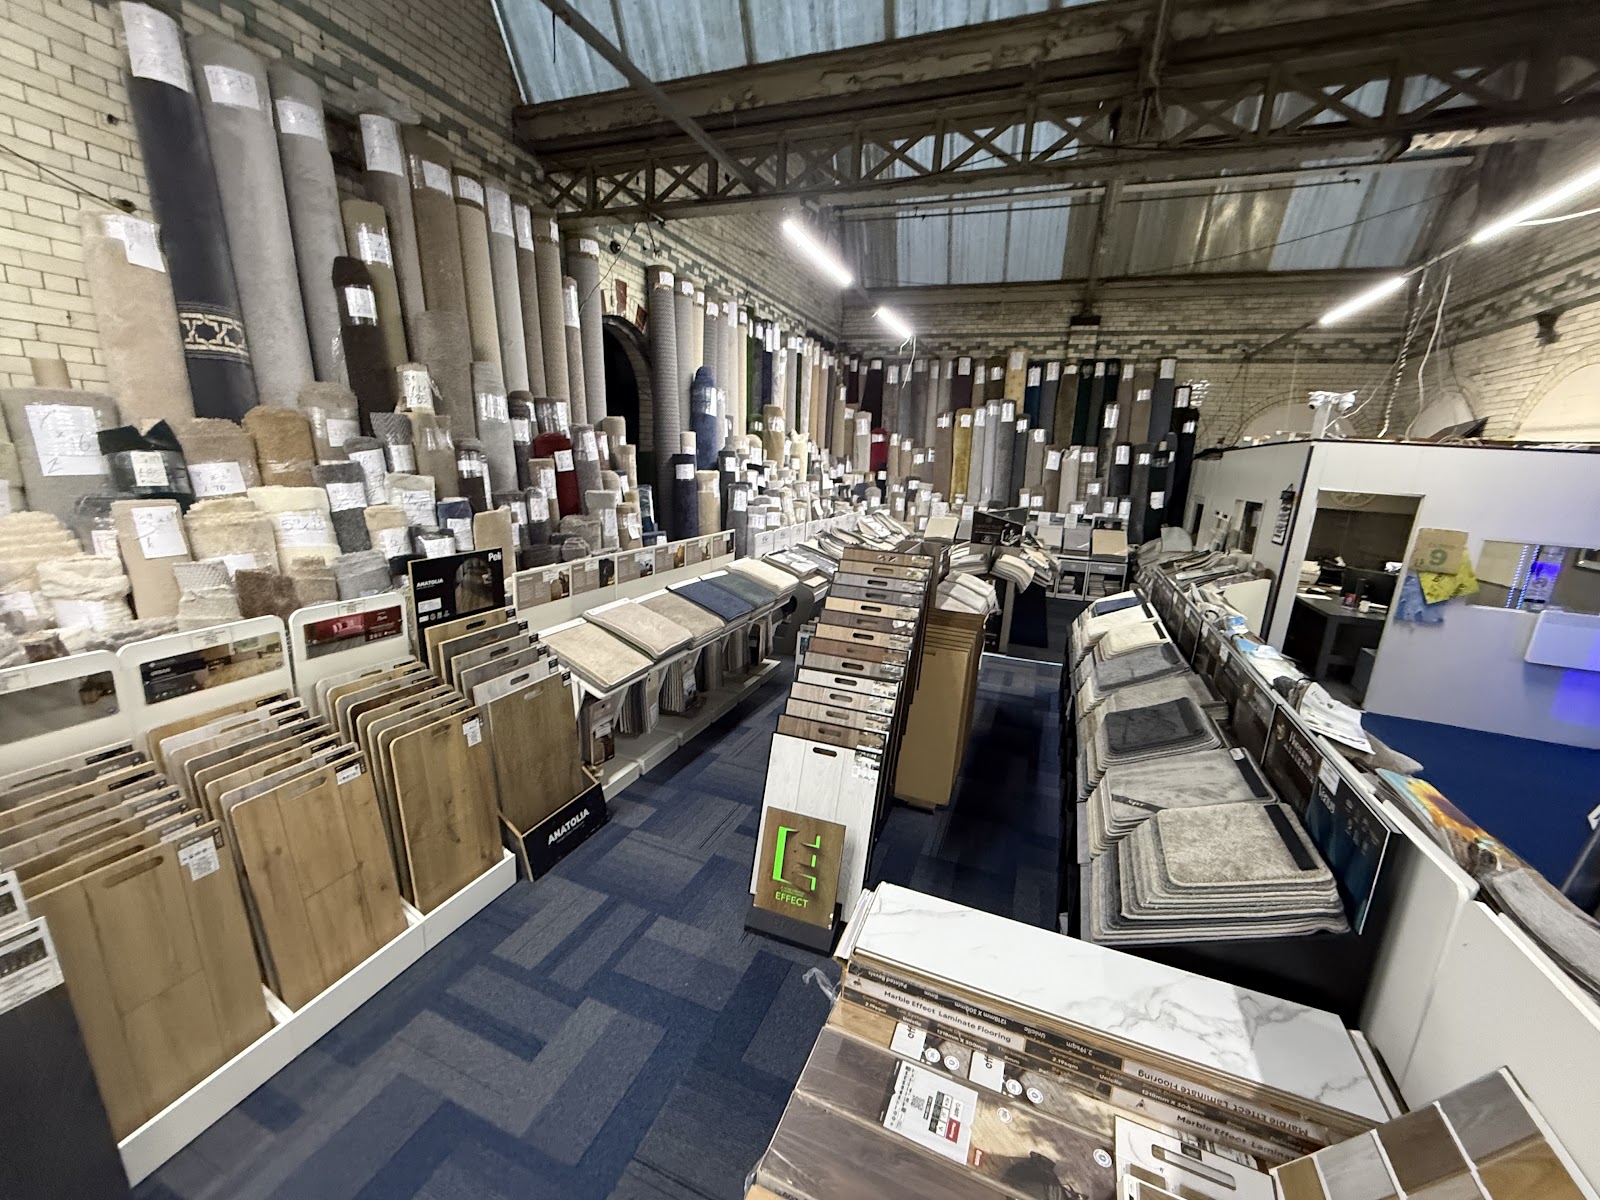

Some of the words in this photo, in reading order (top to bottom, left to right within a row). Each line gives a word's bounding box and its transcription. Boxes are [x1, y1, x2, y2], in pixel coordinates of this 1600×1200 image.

[416, 578, 444, 588] ANATOLIA
[547, 808, 590, 846] ANATOLIA
[775, 891, 809, 908] EFFECT
[884, 990, 910, 1006] Marble
[911, 1000, 936, 1015] Effect
[938, 1010, 976, 1029] Laminate
[977, 1025, 1011, 1044] Flooring
[1137, 1068, 1179, 1092] Flooring
[1180, 1085, 1229, 1109] Laminate
[1176, 1114, 1212, 1132] Marble
[1213, 1128, 1248, 1145] Effect
